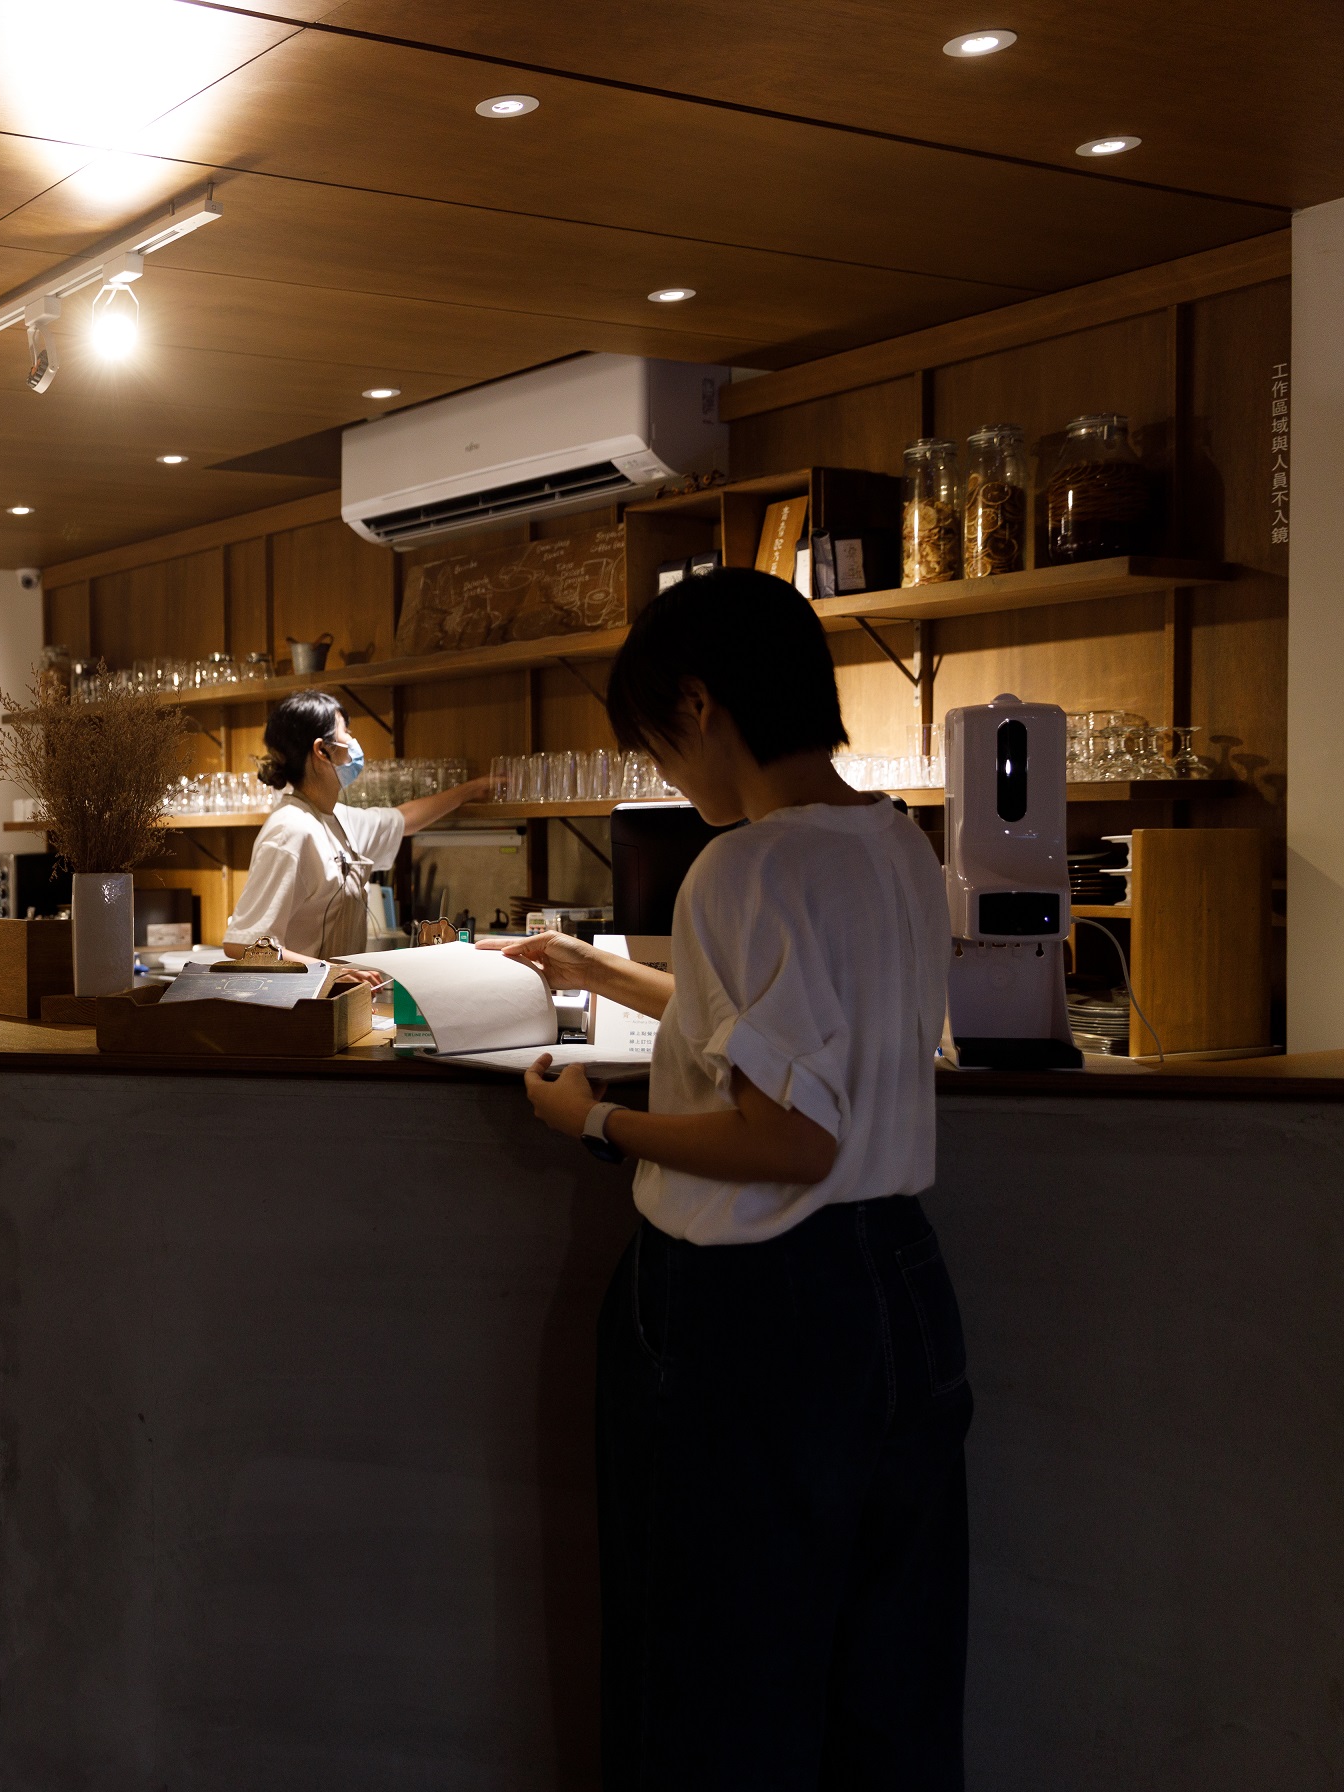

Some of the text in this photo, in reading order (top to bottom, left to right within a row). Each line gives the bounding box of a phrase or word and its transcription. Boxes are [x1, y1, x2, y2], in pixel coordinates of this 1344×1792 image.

[1271, 362, 1289, 544] 工作區域與人員不入鏡
